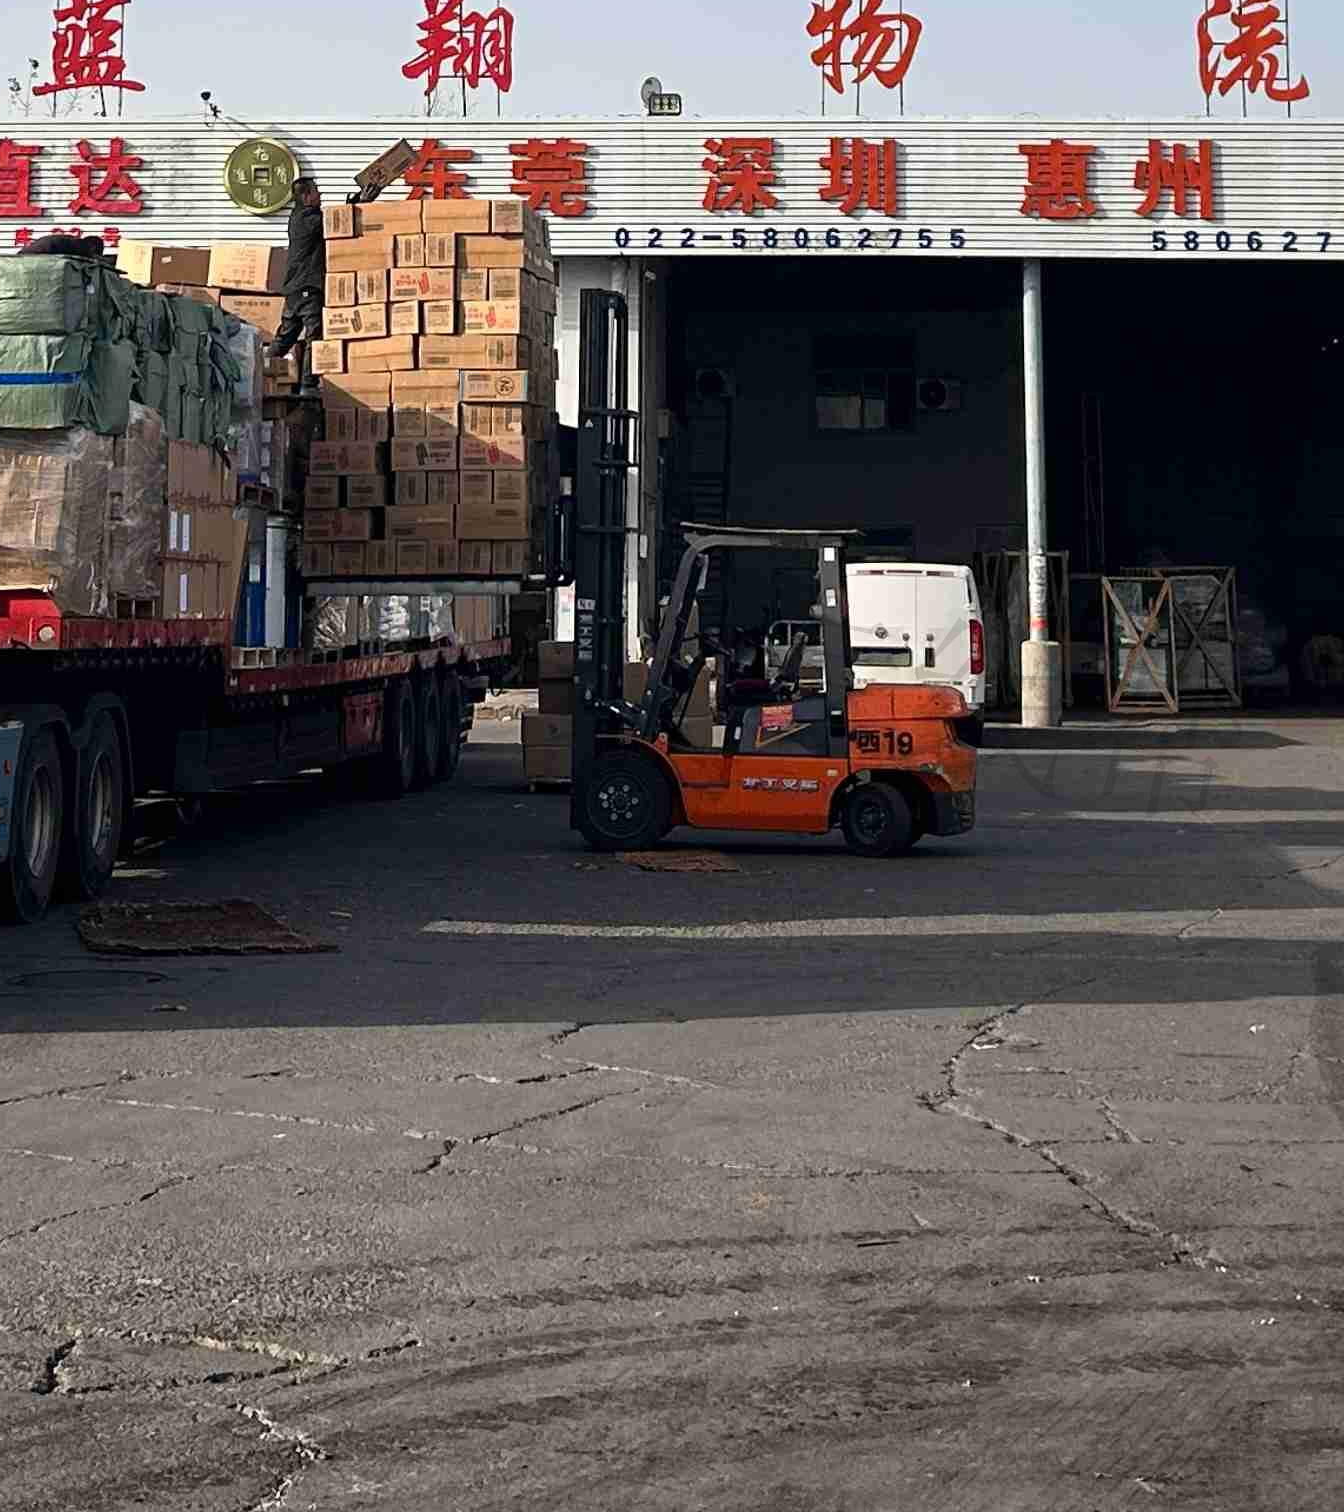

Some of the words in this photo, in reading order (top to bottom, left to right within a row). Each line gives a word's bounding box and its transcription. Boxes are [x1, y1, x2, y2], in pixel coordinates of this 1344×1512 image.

[403, 138, 586, 217] 东莞
[701, 136, 908, 217] 深圳
[1018, 139, 1216, 221] 惠州
[612, 227, 967, 251] 022-58062755
